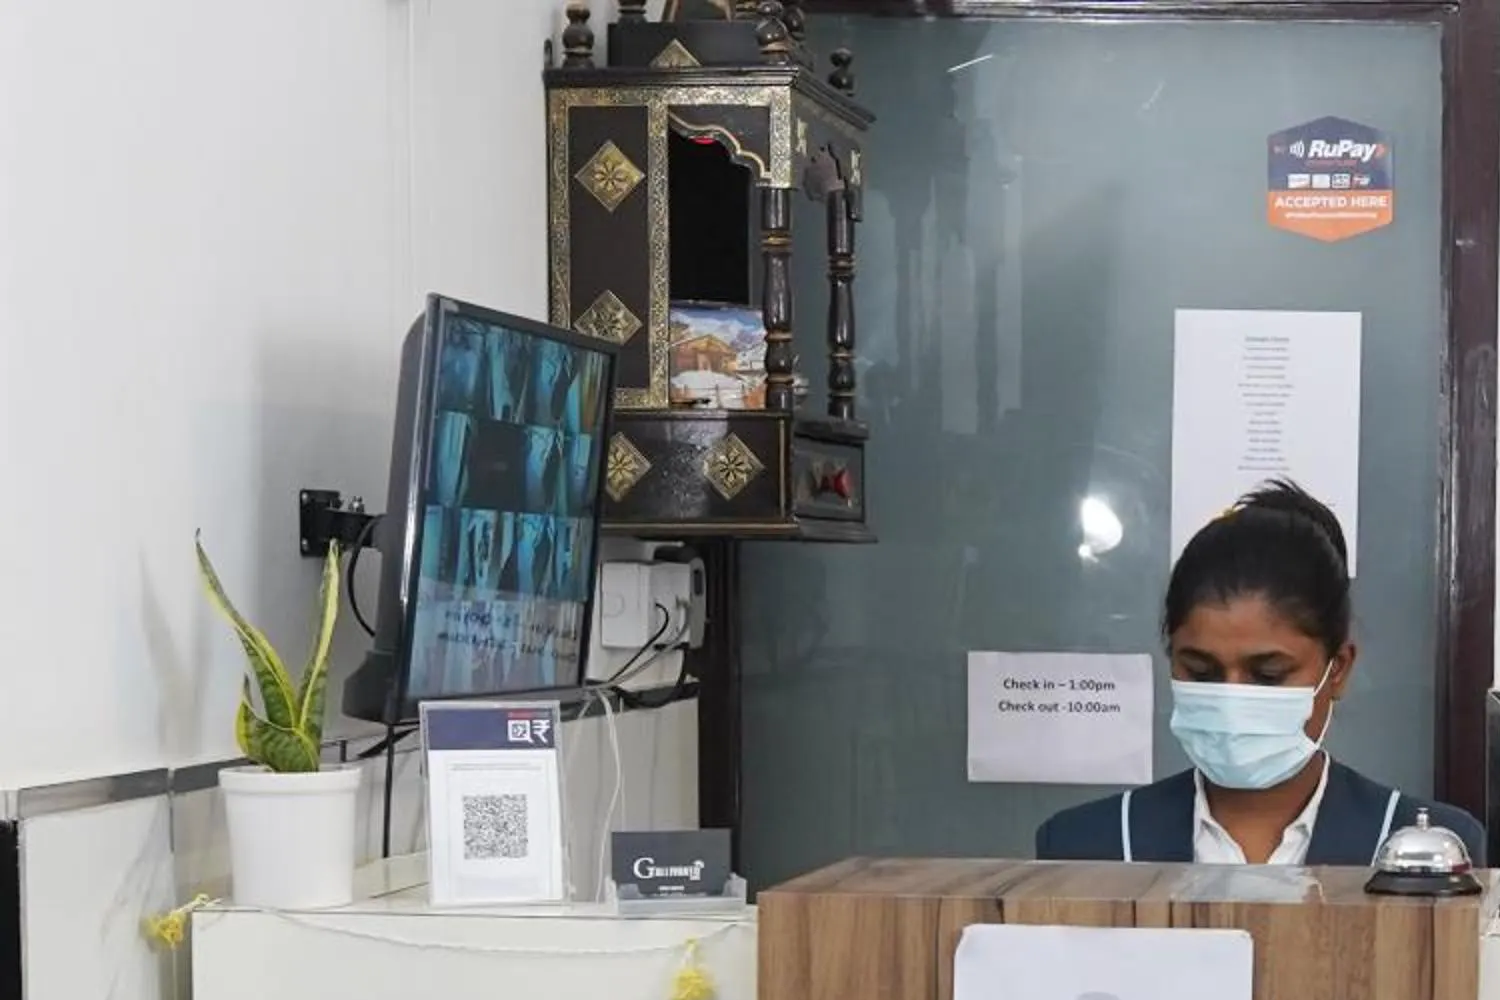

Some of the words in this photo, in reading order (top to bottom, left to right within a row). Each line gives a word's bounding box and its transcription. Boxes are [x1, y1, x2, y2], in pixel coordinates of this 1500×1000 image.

[1308, 139, 1378, 162] RuPay
[1274, 195, 1347, 208] ACCEPTED
[1351, 195, 1389, 207] HERE
[1003, 677, 1040, 691] Check
[1043, 678, 1056, 690] in
[1069, 679, 1116, 692] 1:00pm
[998, 700, 1036, 713] Check
[1038, 702, 1060, 713] out
